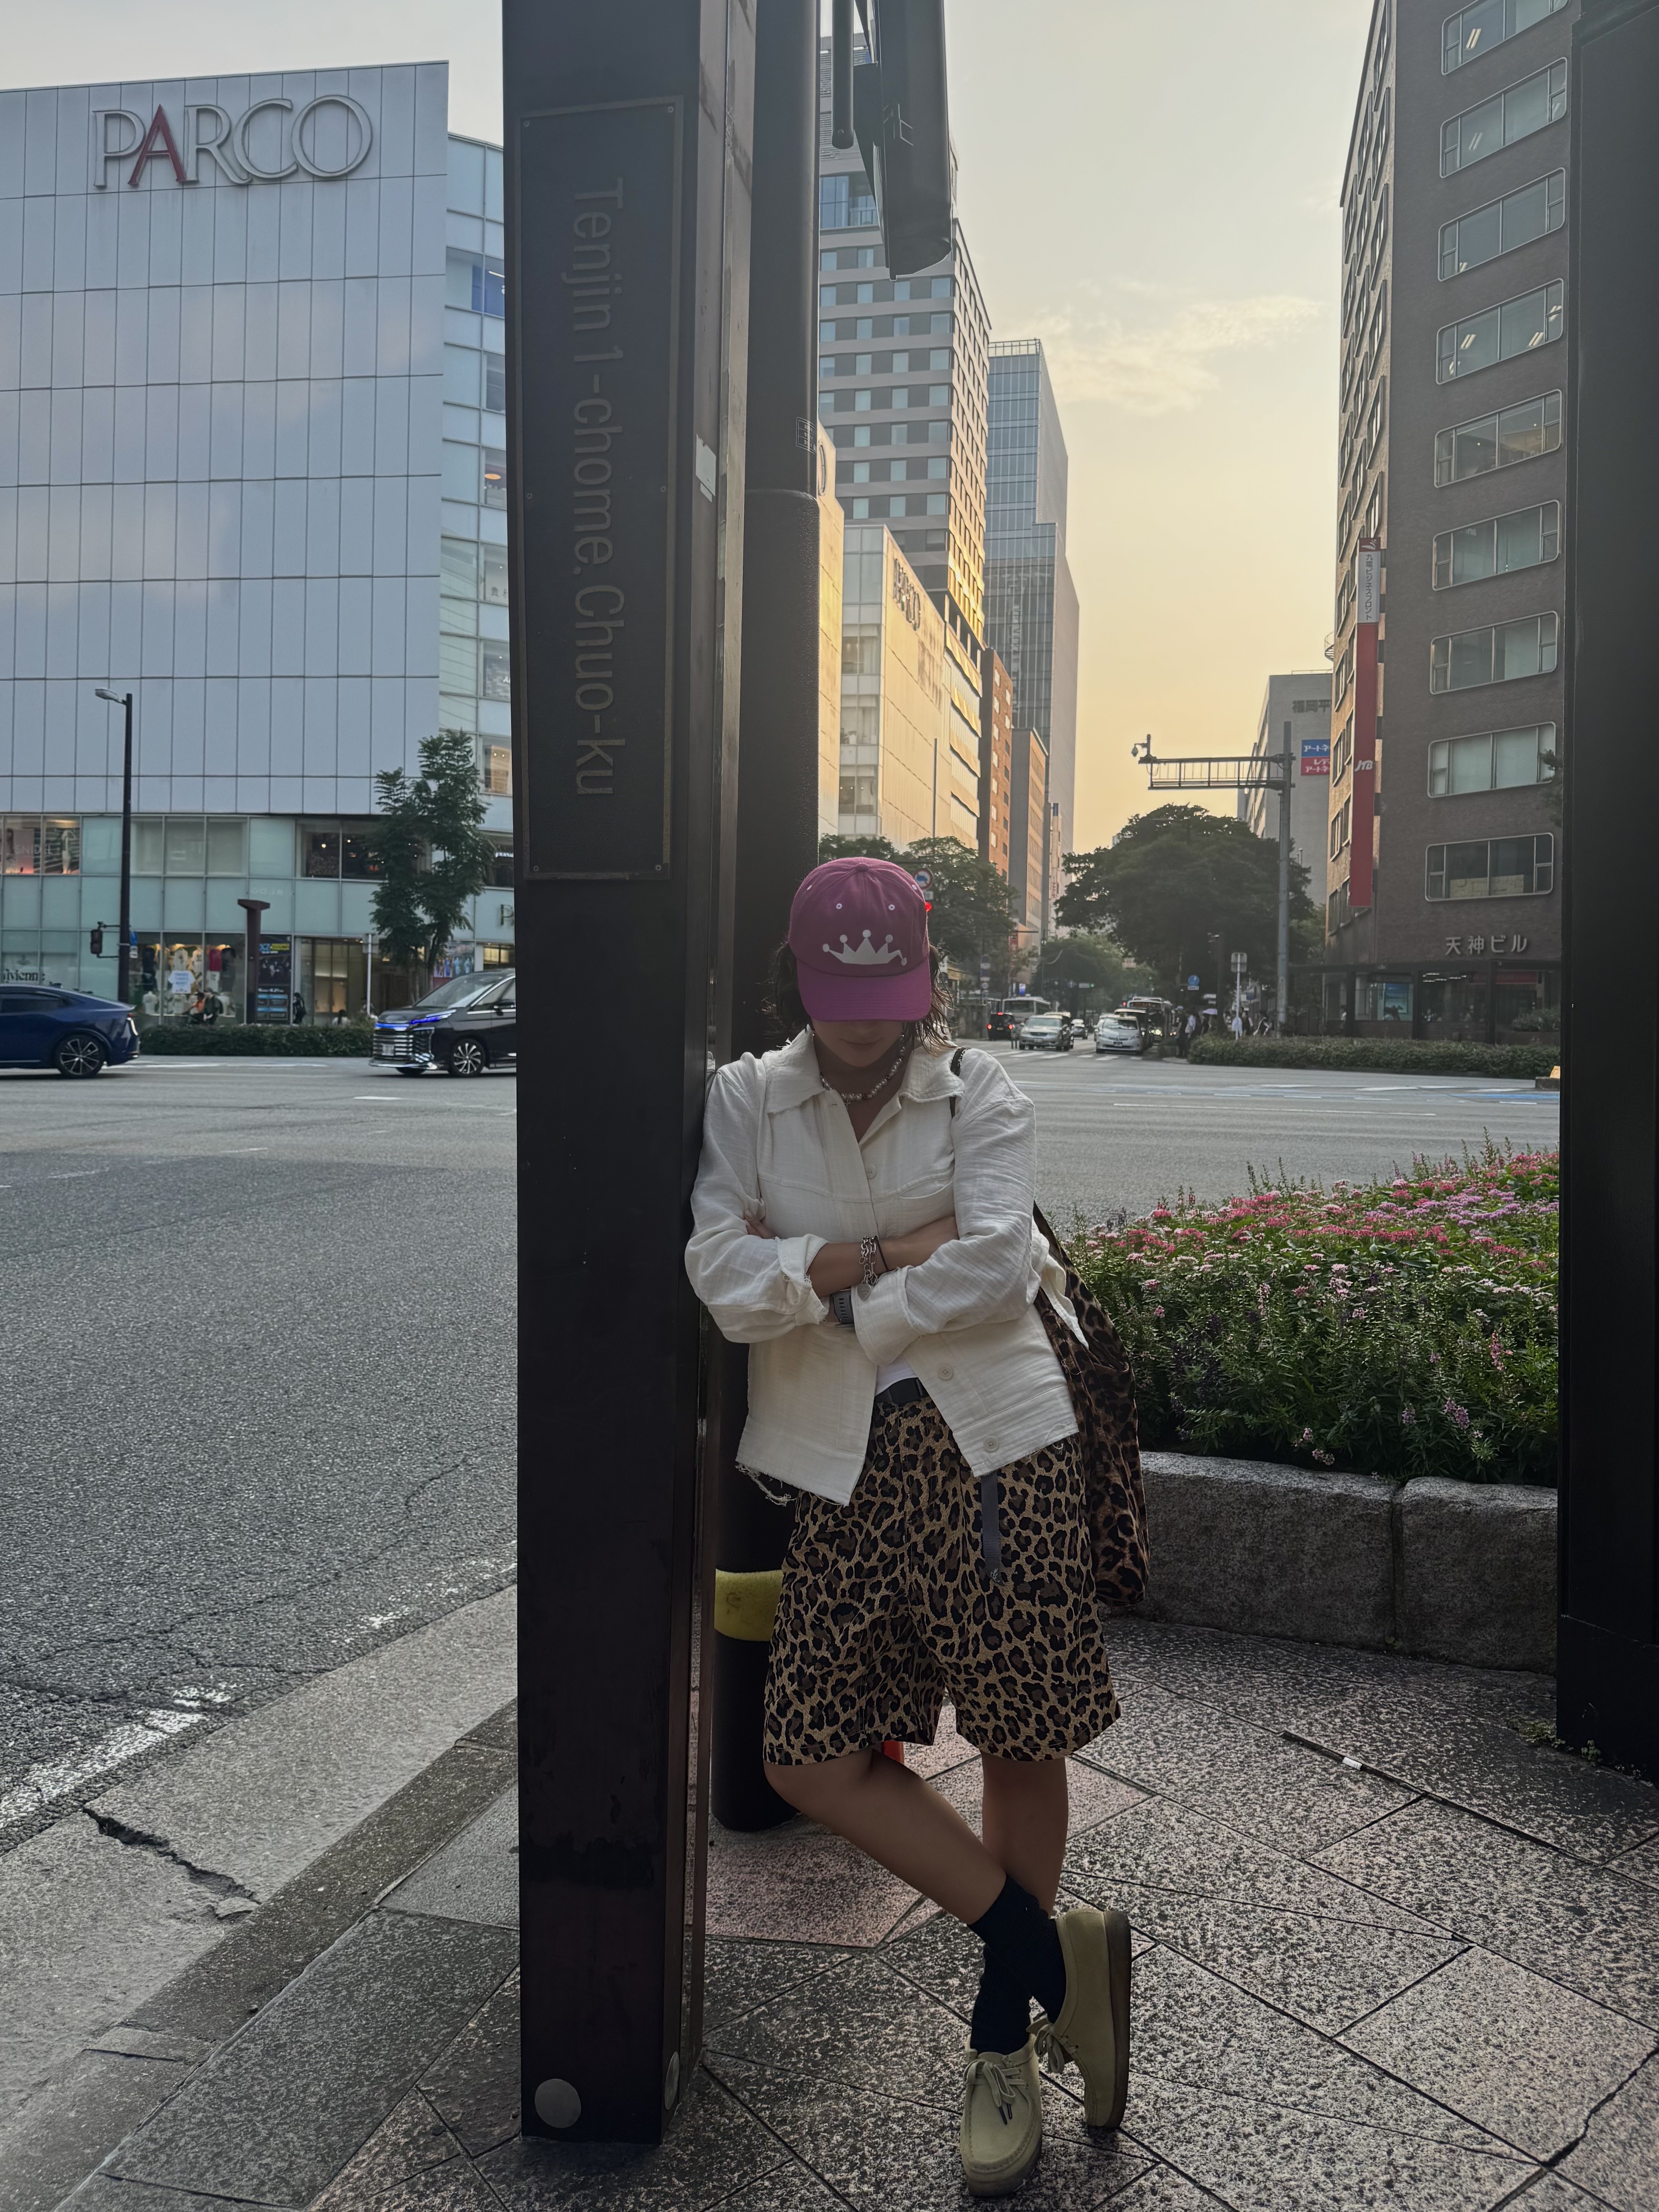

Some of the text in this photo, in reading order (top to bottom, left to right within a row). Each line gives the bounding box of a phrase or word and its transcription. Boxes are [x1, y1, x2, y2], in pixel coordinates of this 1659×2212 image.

[93, 94, 373, 188] PARCO
[561, 178, 623, 330] Tenjin
[1354, 760, 1373, 772] JTB
[1445, 934, 1528, 955] 天神ビル
